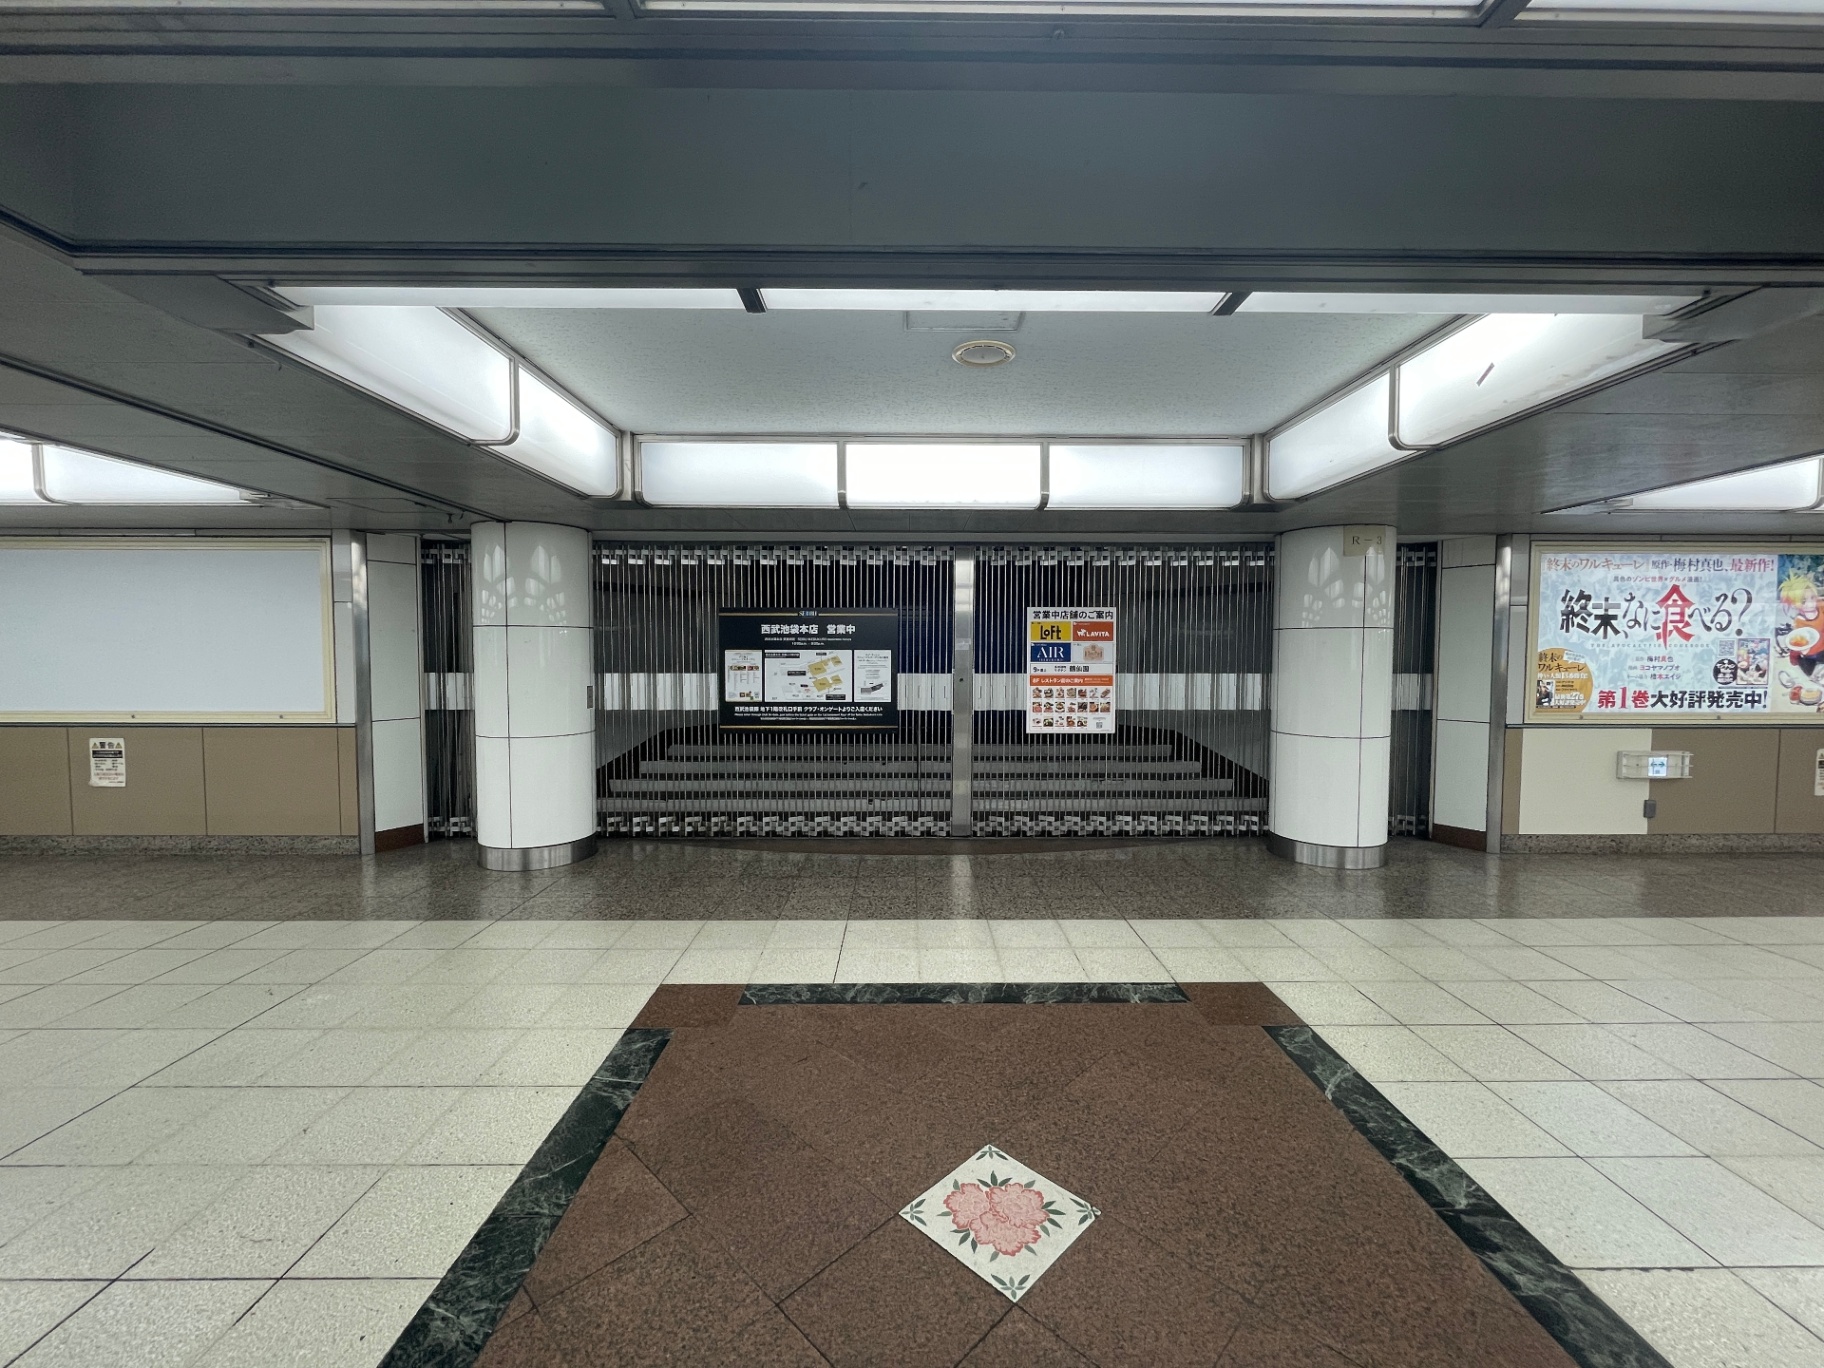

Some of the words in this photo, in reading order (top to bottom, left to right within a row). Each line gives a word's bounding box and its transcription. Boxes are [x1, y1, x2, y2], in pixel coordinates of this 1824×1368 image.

[1032, 610, 1113, 620] 営業中店舗のご案内
[761, 624, 818, 635] 西武池袋本店
[826, 624, 856, 635] 営業中
[1037, 647, 1064, 658] AIR
